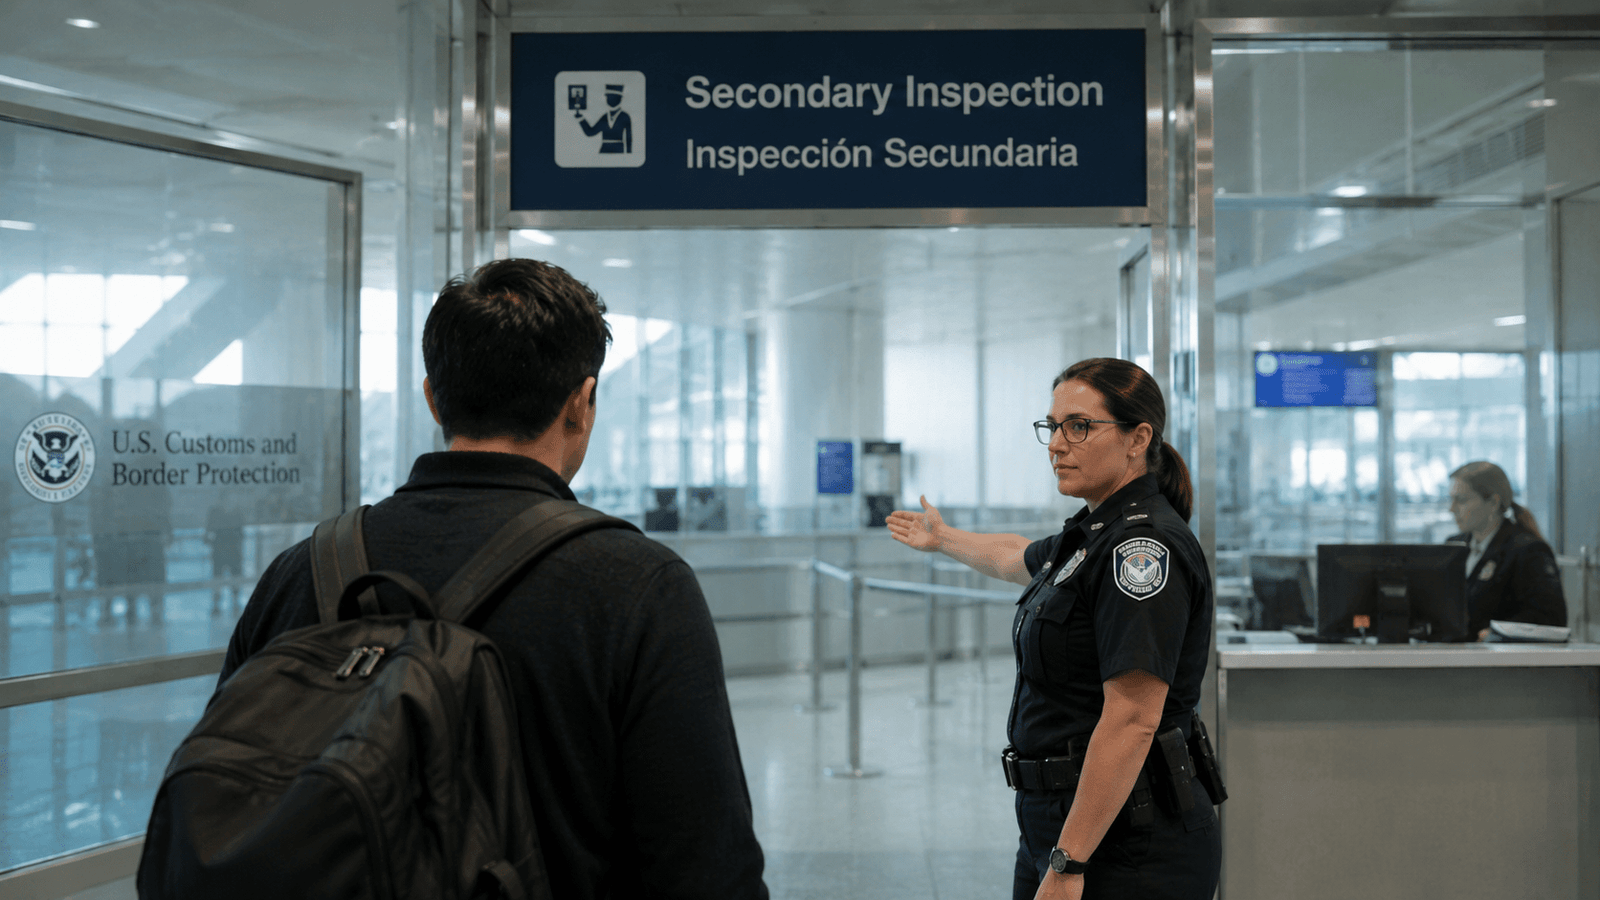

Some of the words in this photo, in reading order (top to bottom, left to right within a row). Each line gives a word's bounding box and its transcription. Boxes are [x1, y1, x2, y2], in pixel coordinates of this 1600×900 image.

[685, 75, 893, 116] Secondary
[906, 74, 1103, 115] Inspection
[686, 138, 873, 176] Inspección
[884, 137, 1079, 168] Secundaria
[112, 430, 158, 455] U.S.
[164, 432, 256, 456] Customs
[261, 433, 297, 456] and
[112, 461, 190, 486] Border
[196, 461, 301, 486] Protection
